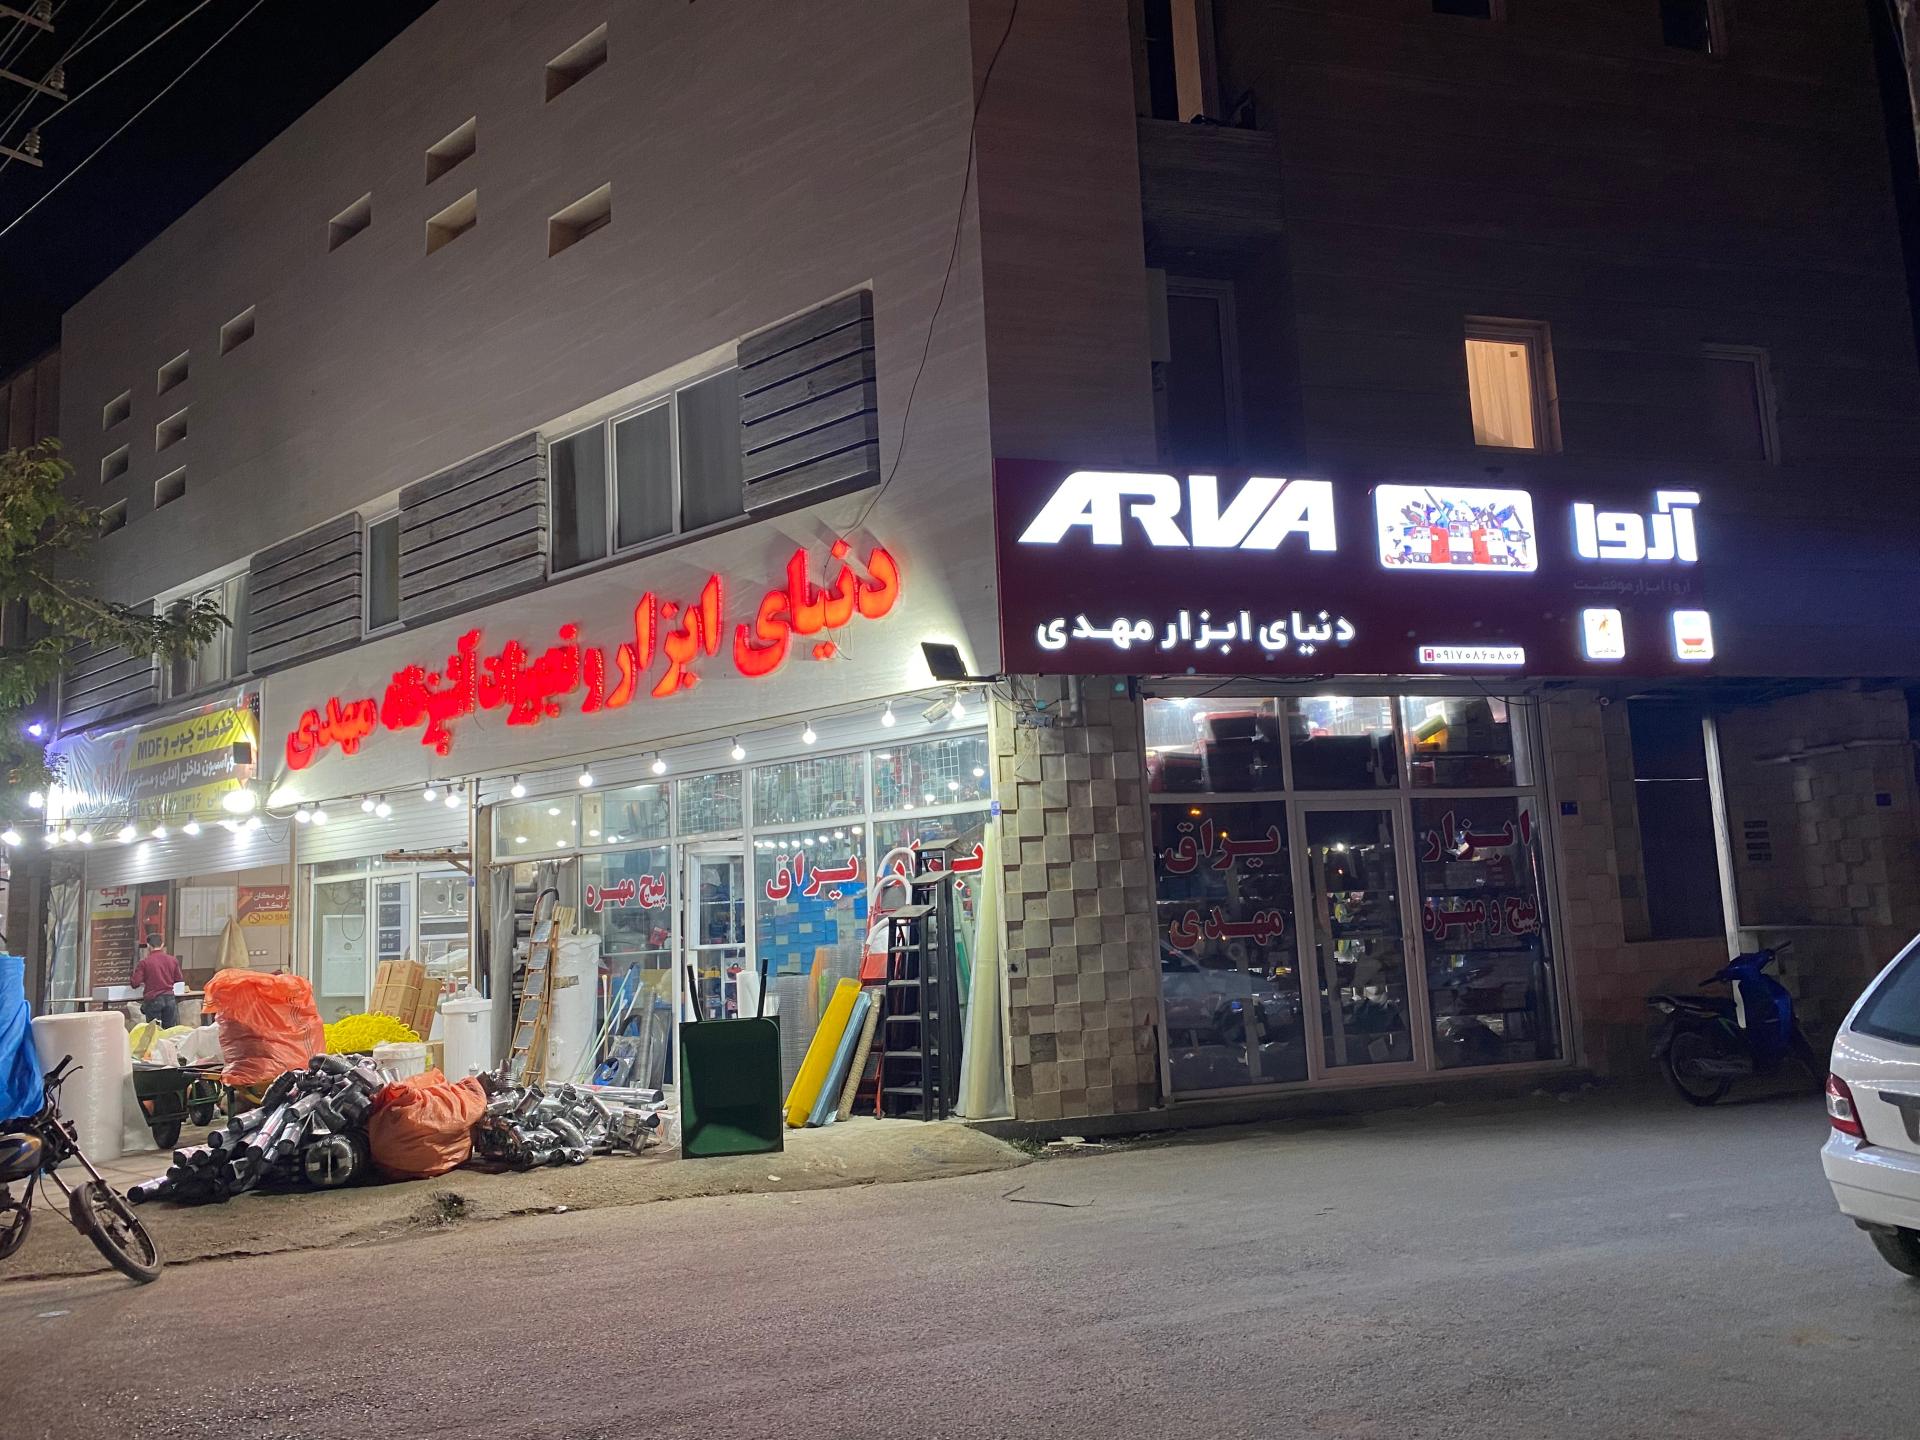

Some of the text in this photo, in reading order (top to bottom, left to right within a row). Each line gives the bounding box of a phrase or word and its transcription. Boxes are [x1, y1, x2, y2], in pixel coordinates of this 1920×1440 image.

[1018, 471, 1337, 553] ARVA
[1574, 490, 1701, 563] آروا
[734, 539, 899, 678] دنیای
[1037, 609, 1356, 656] دنیای ابزار مهدی
[605, 572, 723, 708] ابزار
[581, 647, 605, 713] و
[137, 737, 162, 761] MDF
[170, 728, 194, 753] چوب
[197, 708, 233, 741] خدمات
[286, 696, 377, 770] مهدی
[202, 752, 235, 777] وراسیون
[1164, 817, 1282, 874] یراق
[1421, 809, 1532, 863] ابزار
[586, 871, 667, 913] پیچ مهره
[765, 850, 860, 902] یراق
[1169, 906, 1285, 951] مهدی
[1421, 894, 1541, 941] پیچ و مهره
